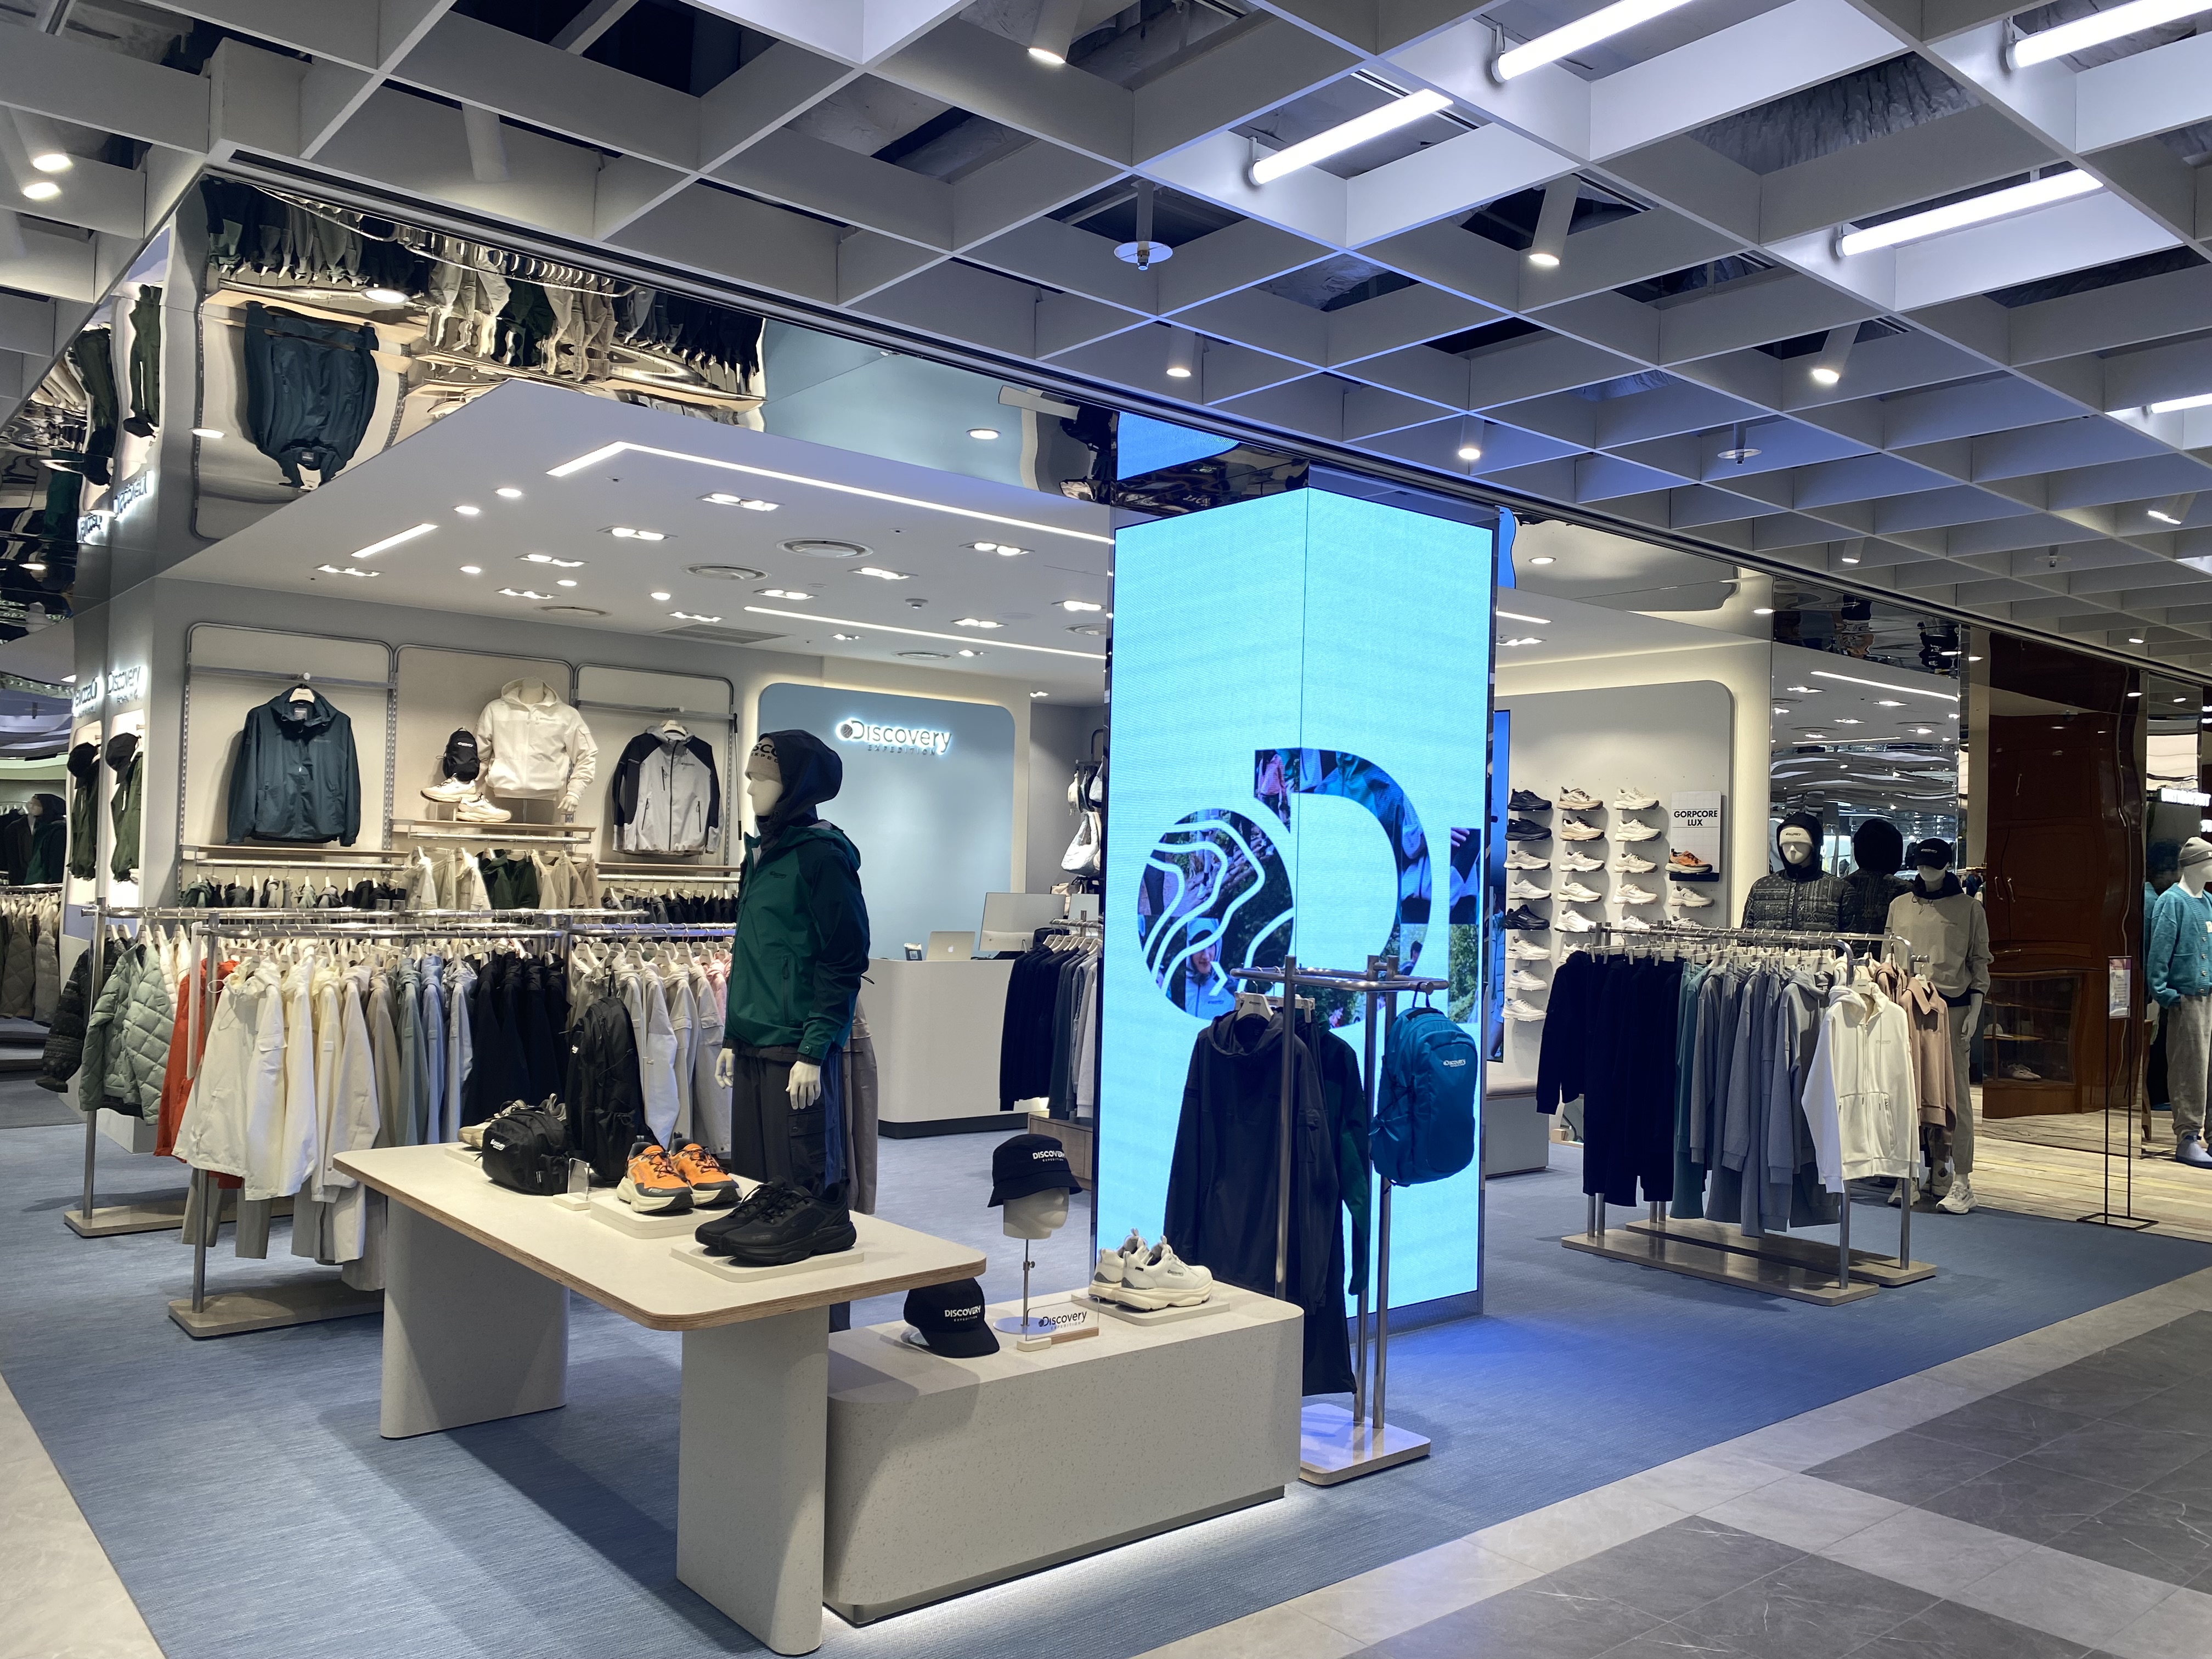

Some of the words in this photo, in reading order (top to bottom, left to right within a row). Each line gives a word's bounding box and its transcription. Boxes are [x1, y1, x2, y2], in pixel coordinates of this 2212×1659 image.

[851, 720, 952, 753] Discovery
[867, 744, 935, 756] EXPEDITION
[945, 1305, 981, 1317] DISCOVERY
[1042, 1311, 1087, 1327] Discovery
